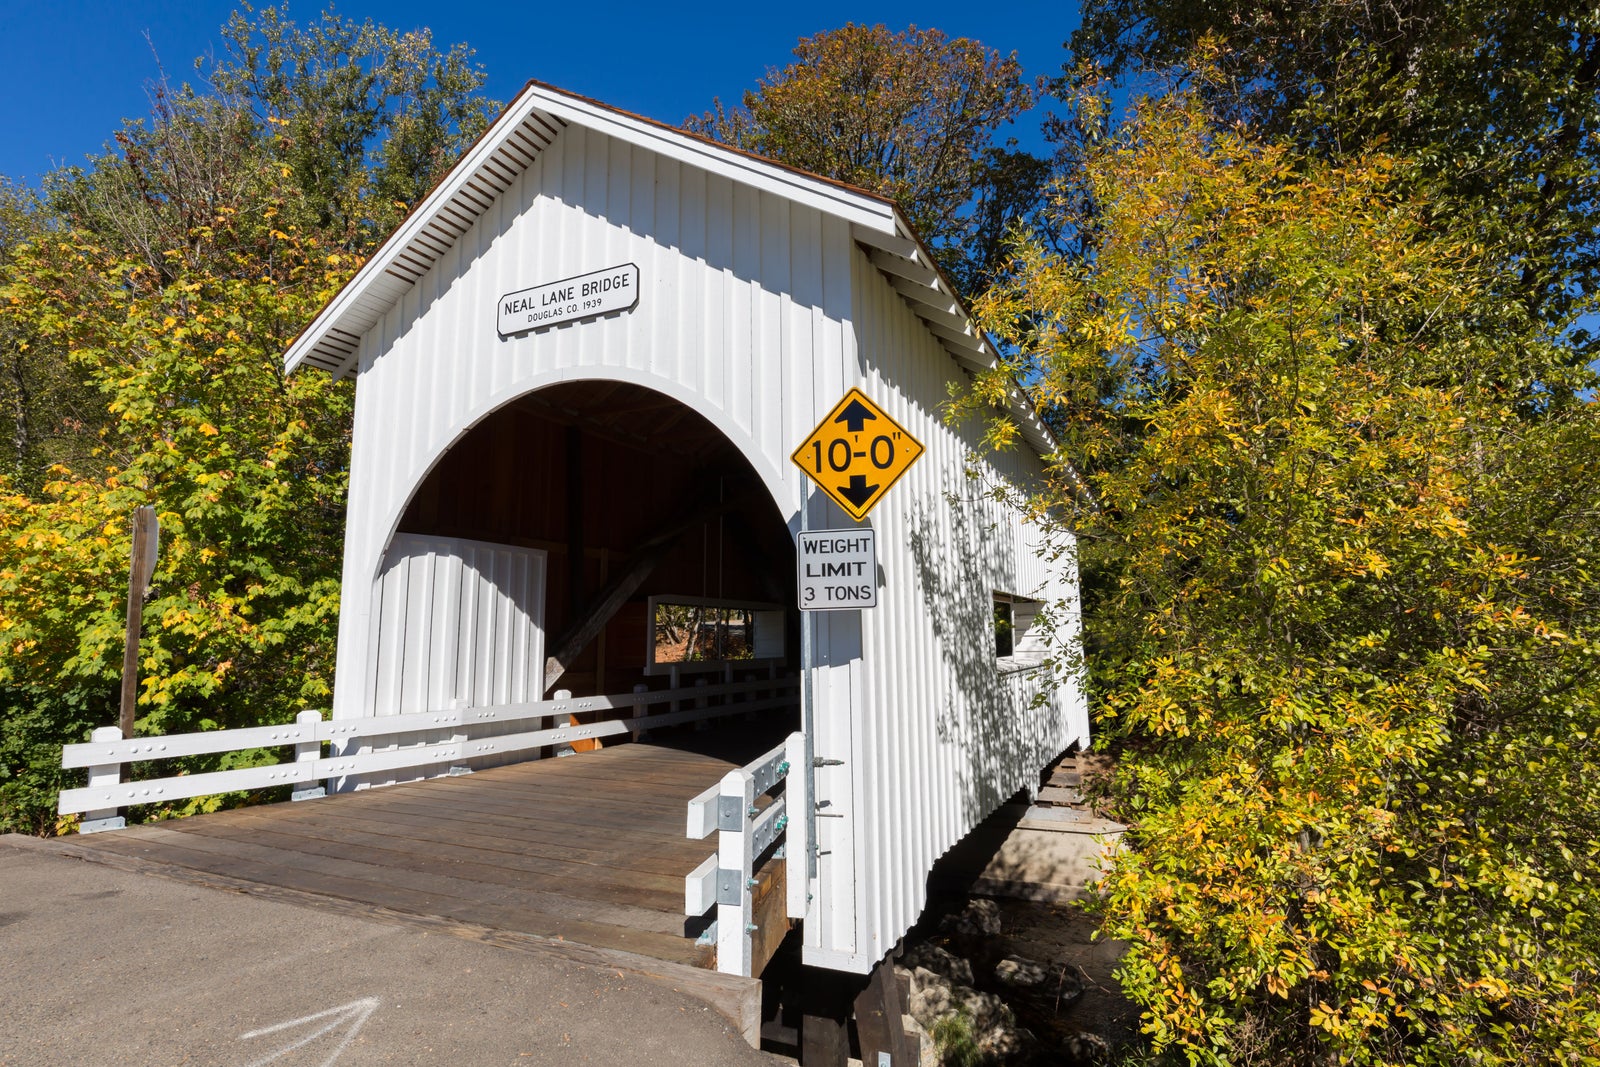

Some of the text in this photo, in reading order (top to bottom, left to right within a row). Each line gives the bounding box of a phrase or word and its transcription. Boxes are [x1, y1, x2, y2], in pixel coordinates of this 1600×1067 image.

[504, 273, 630, 315] NEAL LANE BRIDGE
[527, 298, 602, 322] DOUGLAS CO. 1939
[803, 538, 871, 554] WEIGHT
[806, 562, 867, 577] LIMIT
[804, 585, 871, 601] 3 TONS
